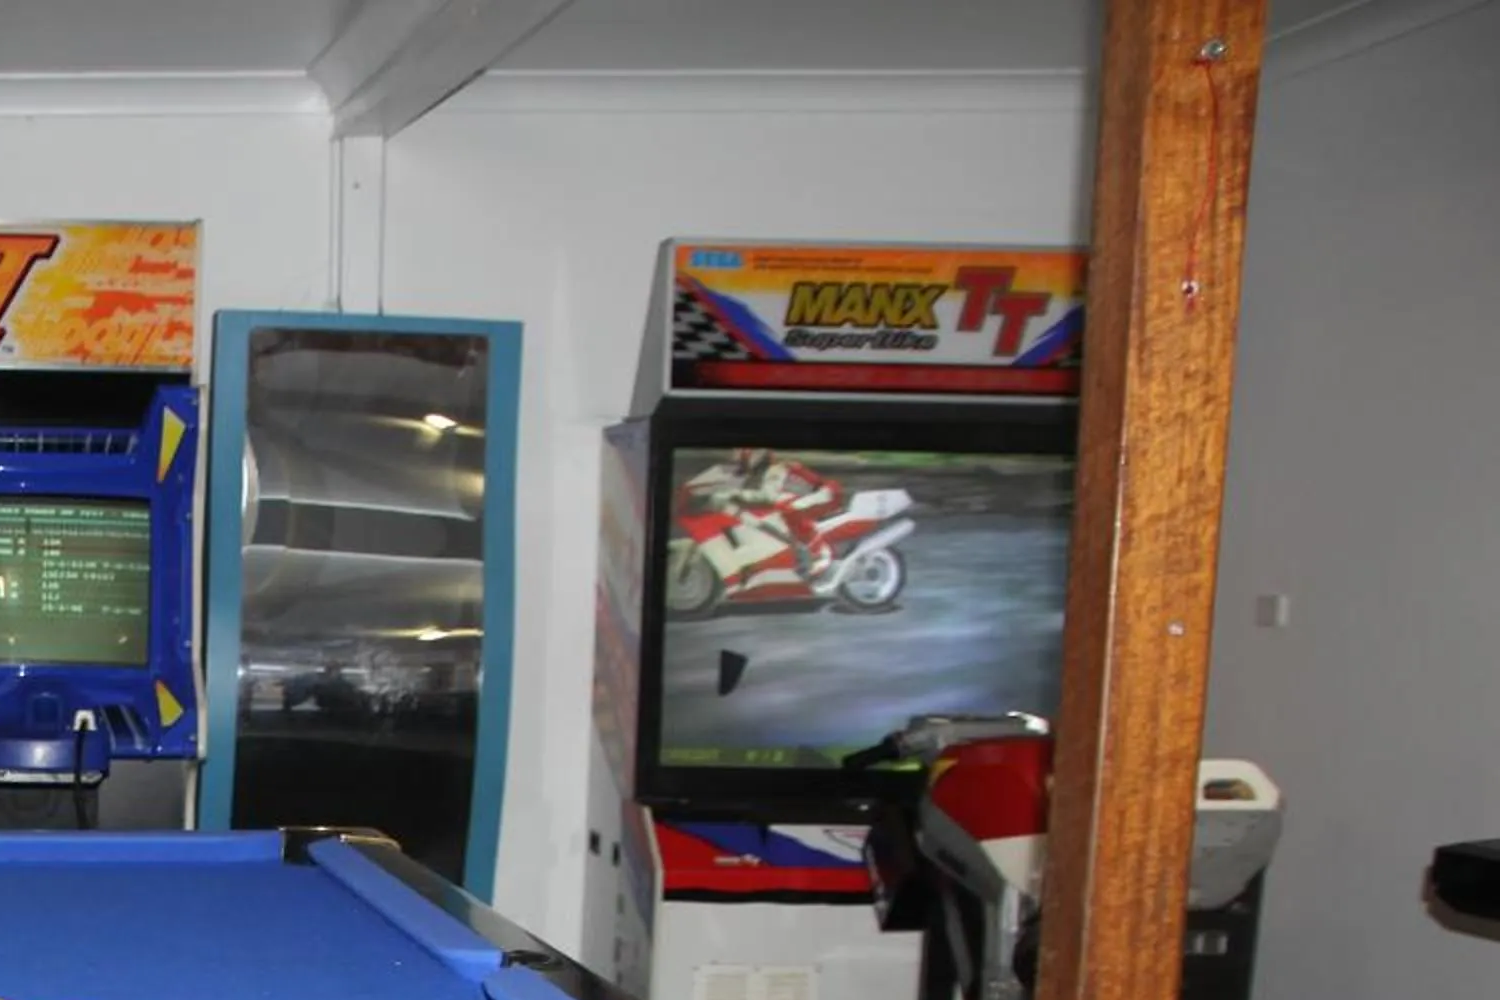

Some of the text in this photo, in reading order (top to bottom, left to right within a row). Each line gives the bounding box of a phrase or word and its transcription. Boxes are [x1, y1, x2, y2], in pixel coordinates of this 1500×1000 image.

[692, 252, 743, 268] SEGA
[784, 265, 1053, 357] MANX TT
